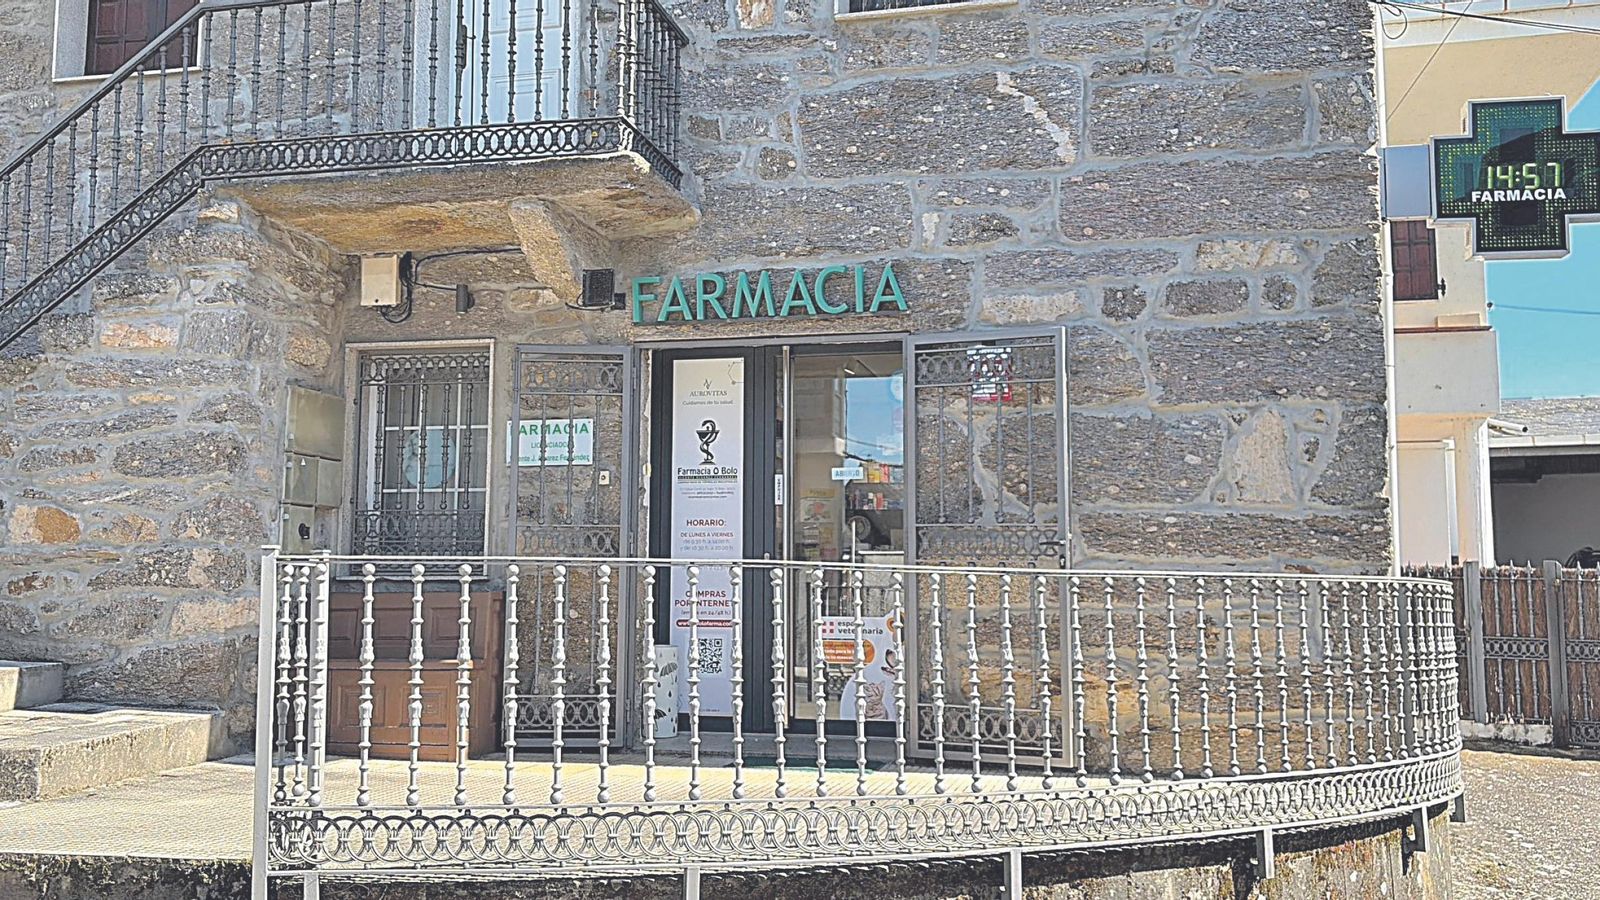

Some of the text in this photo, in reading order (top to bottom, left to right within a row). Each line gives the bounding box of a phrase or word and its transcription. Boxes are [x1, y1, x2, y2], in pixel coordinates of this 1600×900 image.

[1487, 162, 1561, 190] 14:57
[1471, 188, 1567, 203] FARMACIA
[631, 261, 909, 323] FARMACIA
[519, 423, 589, 435] ARMACIA
[677, 467, 711, 475] Farmacia
[686, 519, 727, 527] HORARIO:
